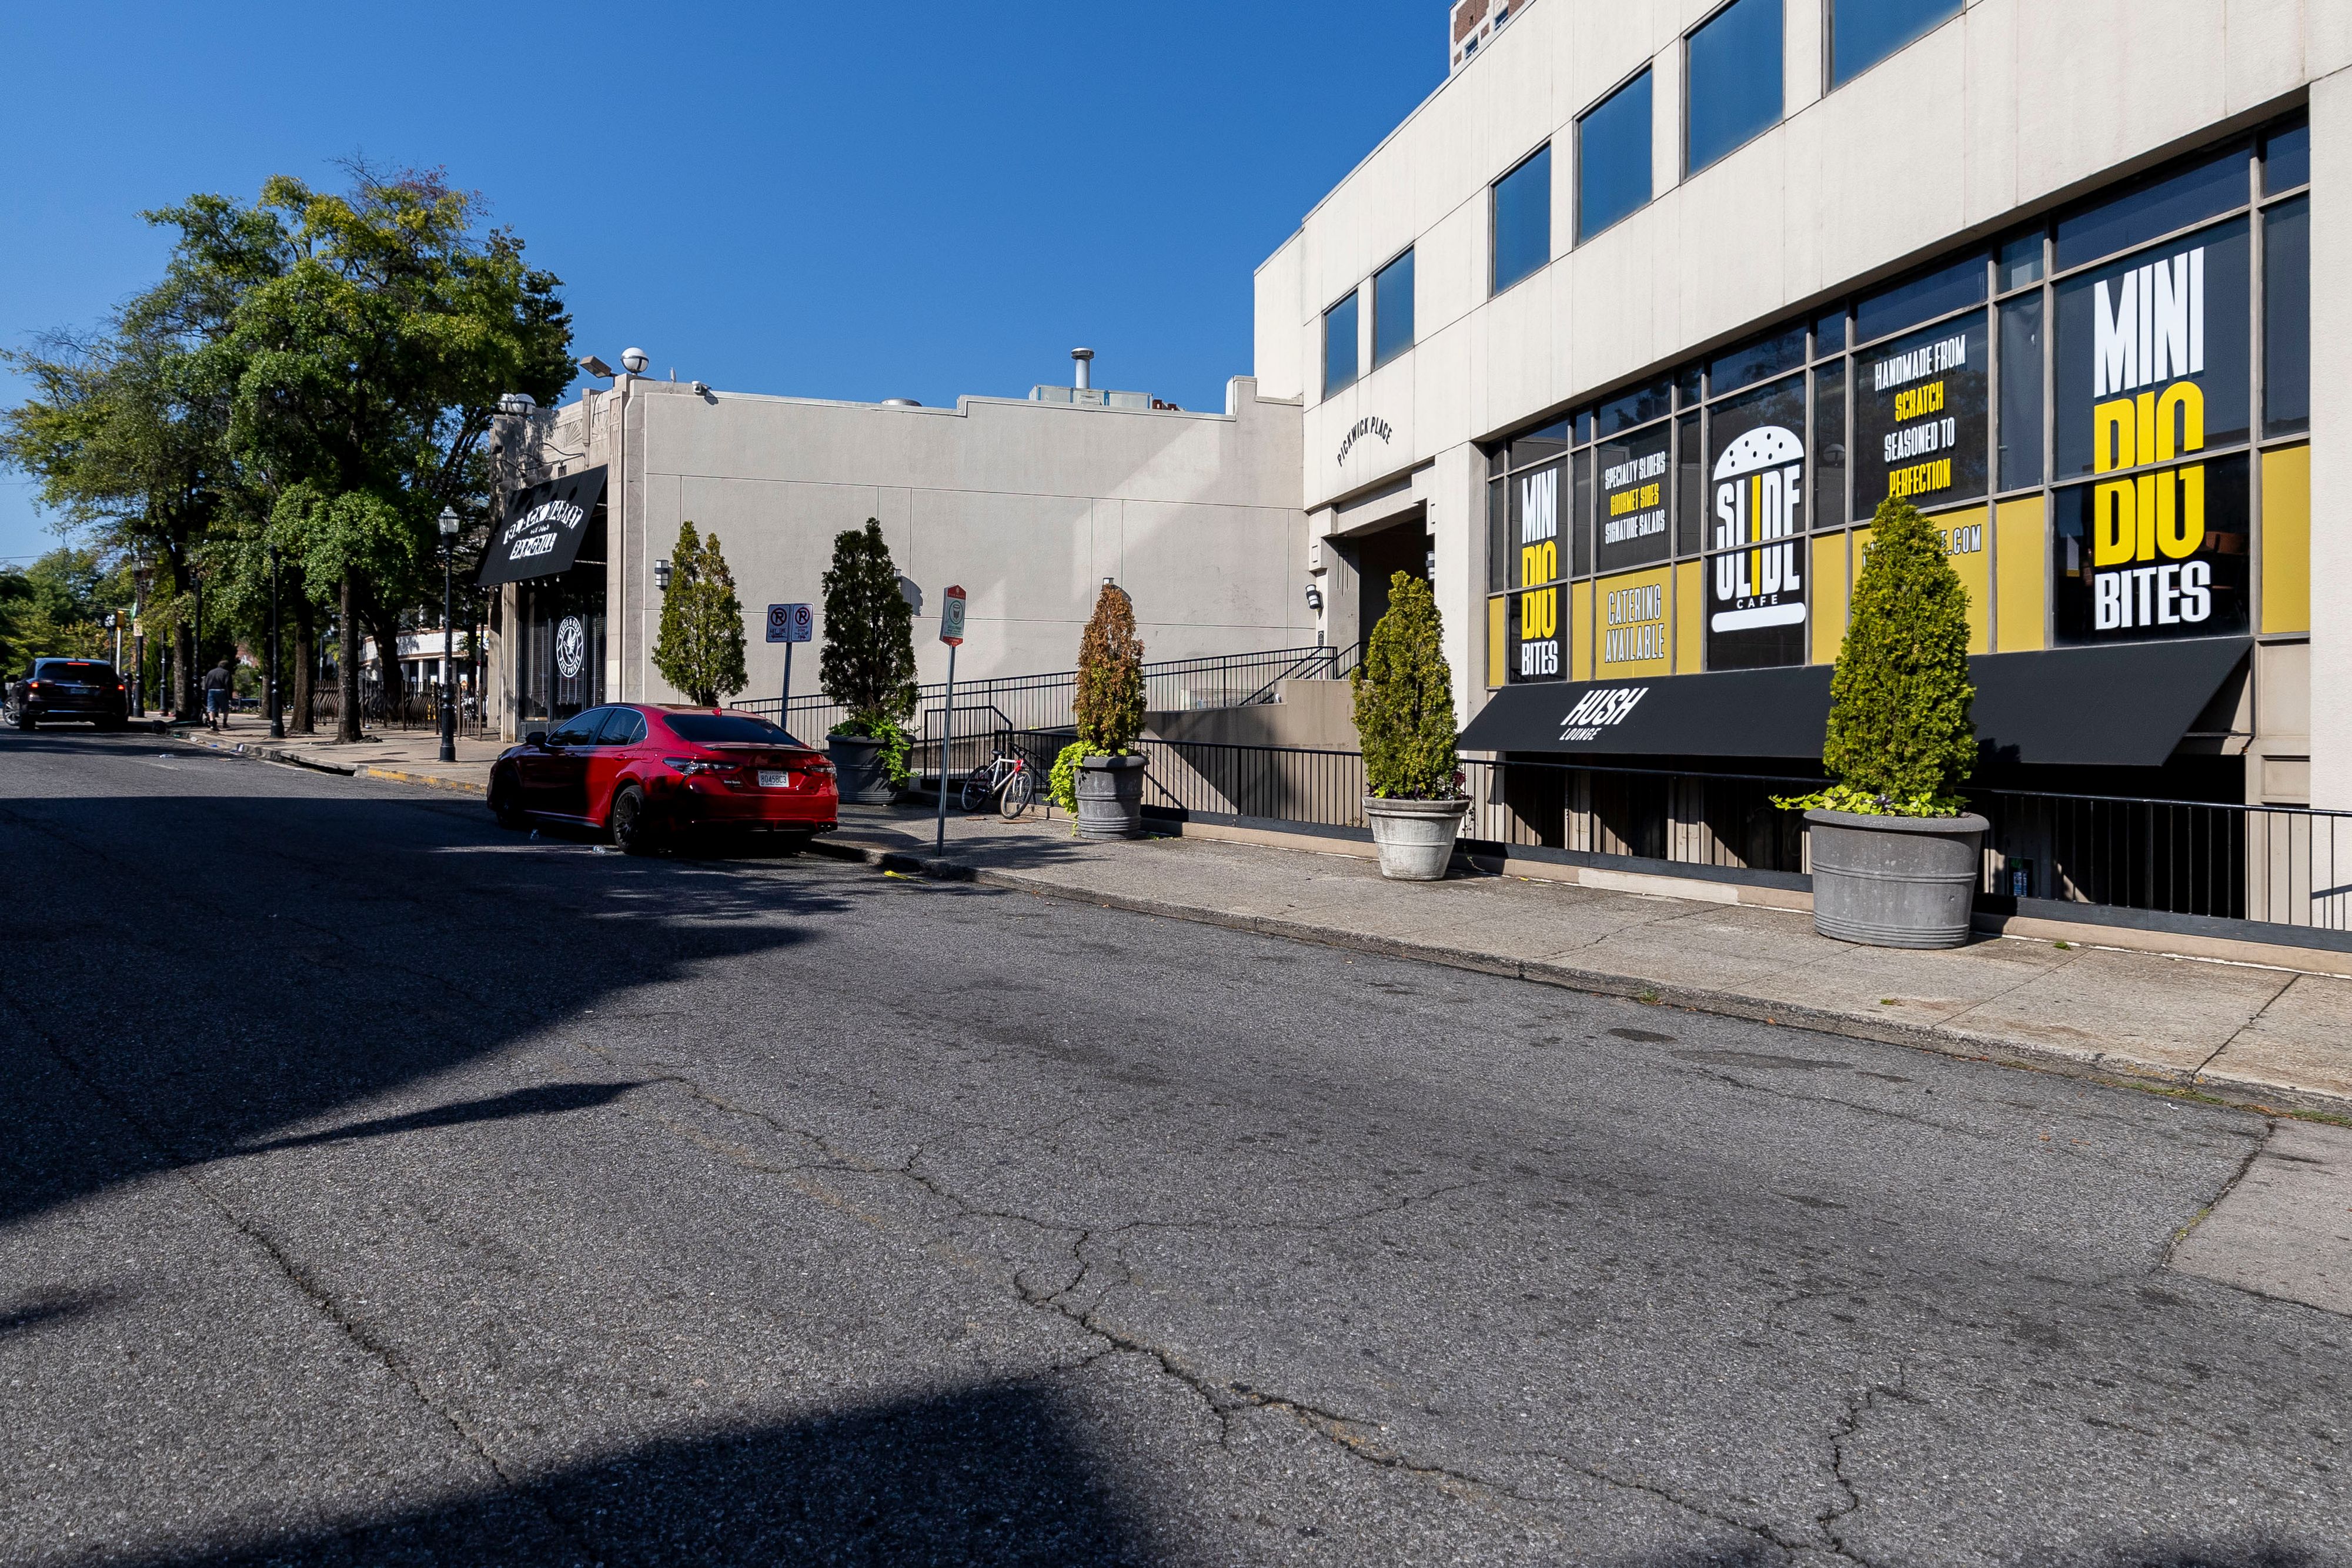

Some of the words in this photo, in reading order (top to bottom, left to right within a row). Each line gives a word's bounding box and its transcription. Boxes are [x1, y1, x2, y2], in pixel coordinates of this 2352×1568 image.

[2093, 246, 2204, 398] MINI
[1875, 345, 1933, 392] HANDMADE
[1935, 334, 1966, 373] FROM
[1895, 380, 1944, 422] SCRATCH
[1337, 417, 1369, 467] PICKWICK
[1370, 416, 1392, 445] PLACE
[1884, 421, 1939, 463] SEASONED
[1940, 417, 1955, 449] TO
[1605, 459, 1638, 490] SPECIALTY
[1639, 451, 1666, 480] SLIDERS
[1889, 457, 1951, 498] PERFECTION
[2093, 380, 2204, 567] BIG
[1522, 467, 1557, 544] MINI
[1611, 488, 1639, 517] GOURMET
[1640, 483, 1659, 509] SIDES
[1605, 516, 1638, 545] SIGNATURE
[1639, 509, 1665, 537] SALADS
[1716, 464, 1800, 601] SLIDE
[1522, 540, 1557, 641] BIG
[1608, 583, 1662, 626] CATERING
[1736, 594, 1779, 609] CAFE
[2094, 560, 2211, 631] BITES
[1521, 640, 1558, 676] BITES
[1605, 623, 1665, 663] AVAILABLE
[1560, 687, 1649, 726] HUSH
[1559, 727, 1602, 741] LOUNGE
